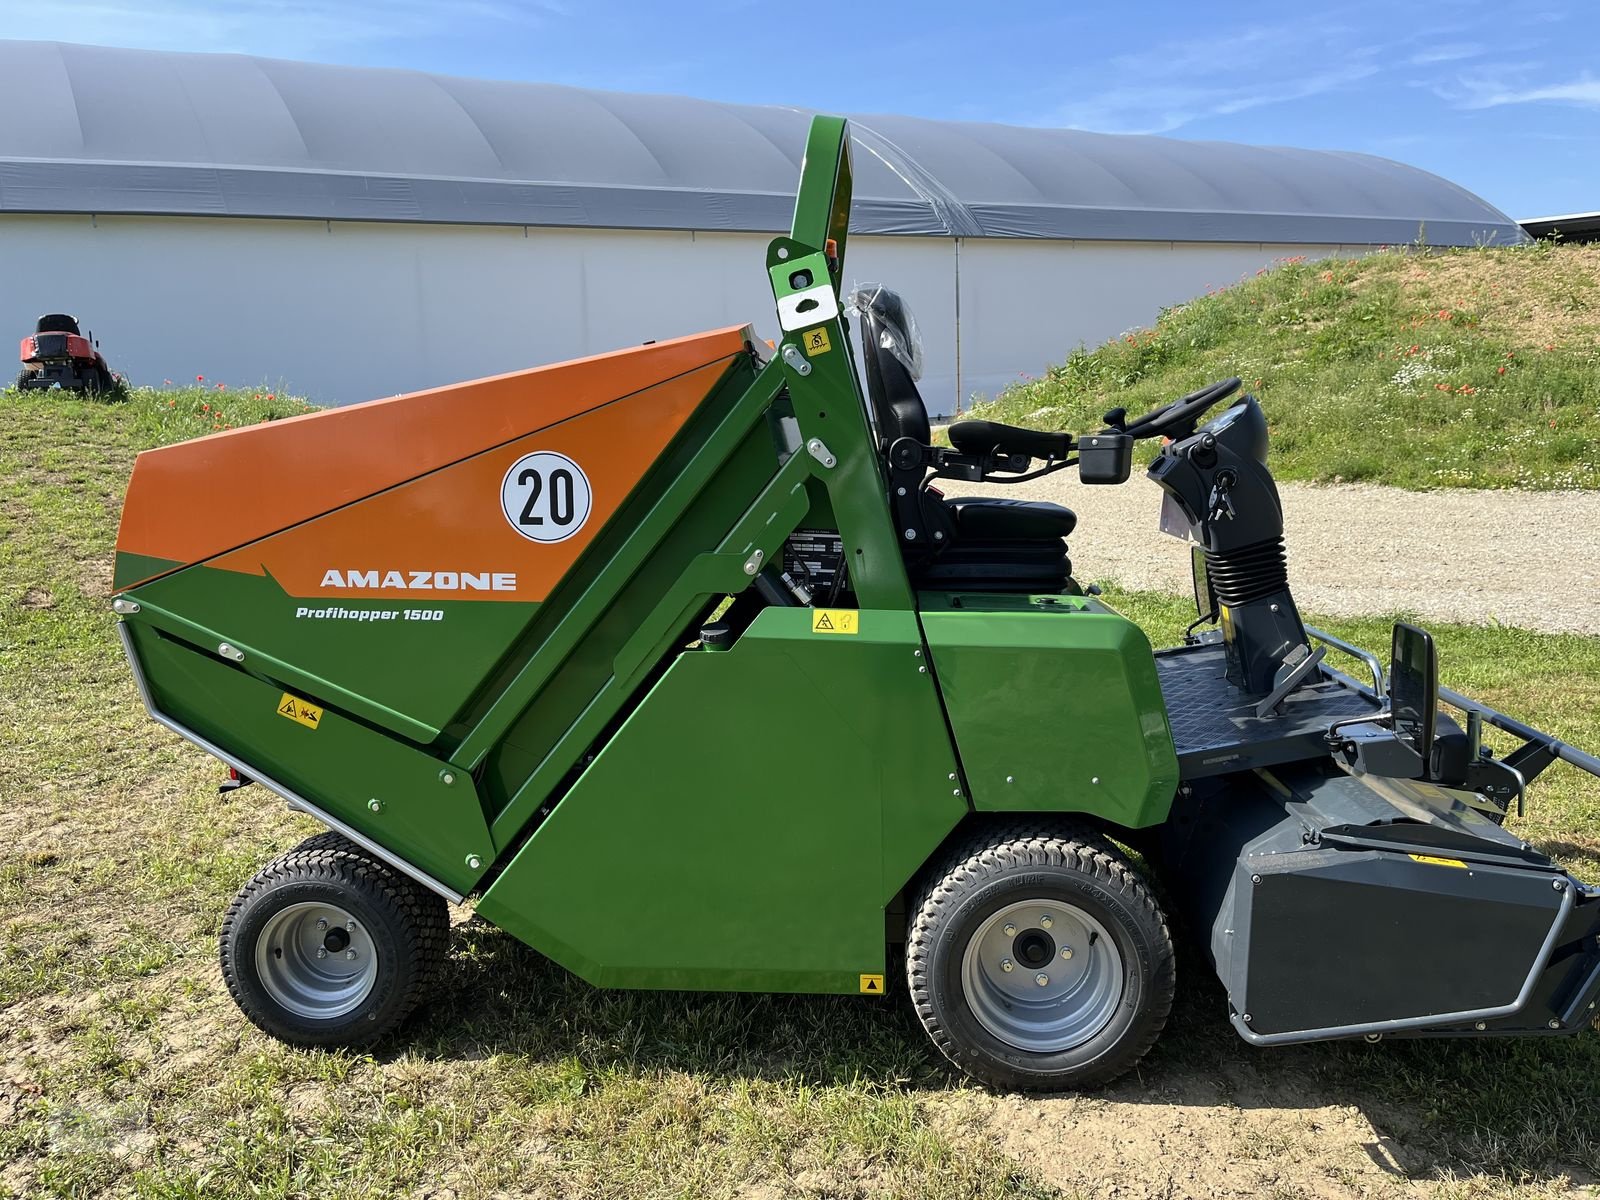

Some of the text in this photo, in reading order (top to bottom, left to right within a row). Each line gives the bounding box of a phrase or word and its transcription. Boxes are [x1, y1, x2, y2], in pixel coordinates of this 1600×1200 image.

[518, 468, 574, 525] 20
[320, 570, 517, 592] AMAZONE
[295, 607, 444, 622] Profihopper 1500
